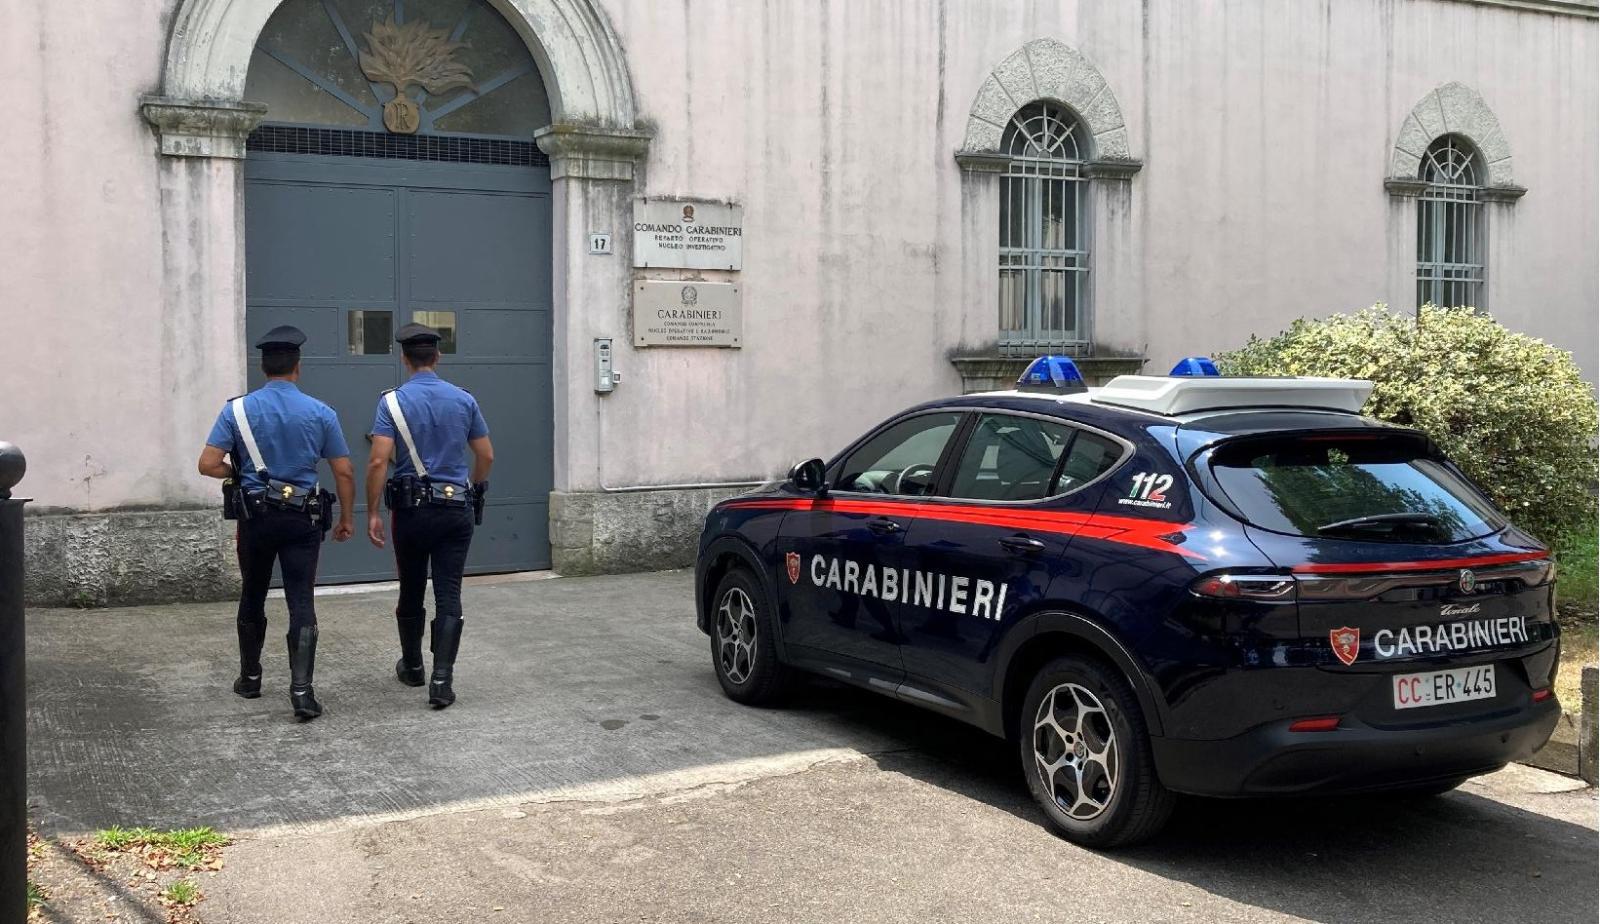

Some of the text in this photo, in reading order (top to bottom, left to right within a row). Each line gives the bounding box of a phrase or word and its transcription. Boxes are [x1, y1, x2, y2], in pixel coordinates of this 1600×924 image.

[634, 223, 742, 236] COMANDO CARABINIERI
[594, 238, 606, 250] 17
[657, 309, 722, 320] CARABINIERI
[1129, 472, 1174, 502] 112
[1118, 498, 1172, 509] www.carabinieri.it
[810, 553, 1008, 621] CARABINIERI
[1374, 616, 1529, 657] CARABINIERI
[1397, 668, 1493, 705] CC ER 445
